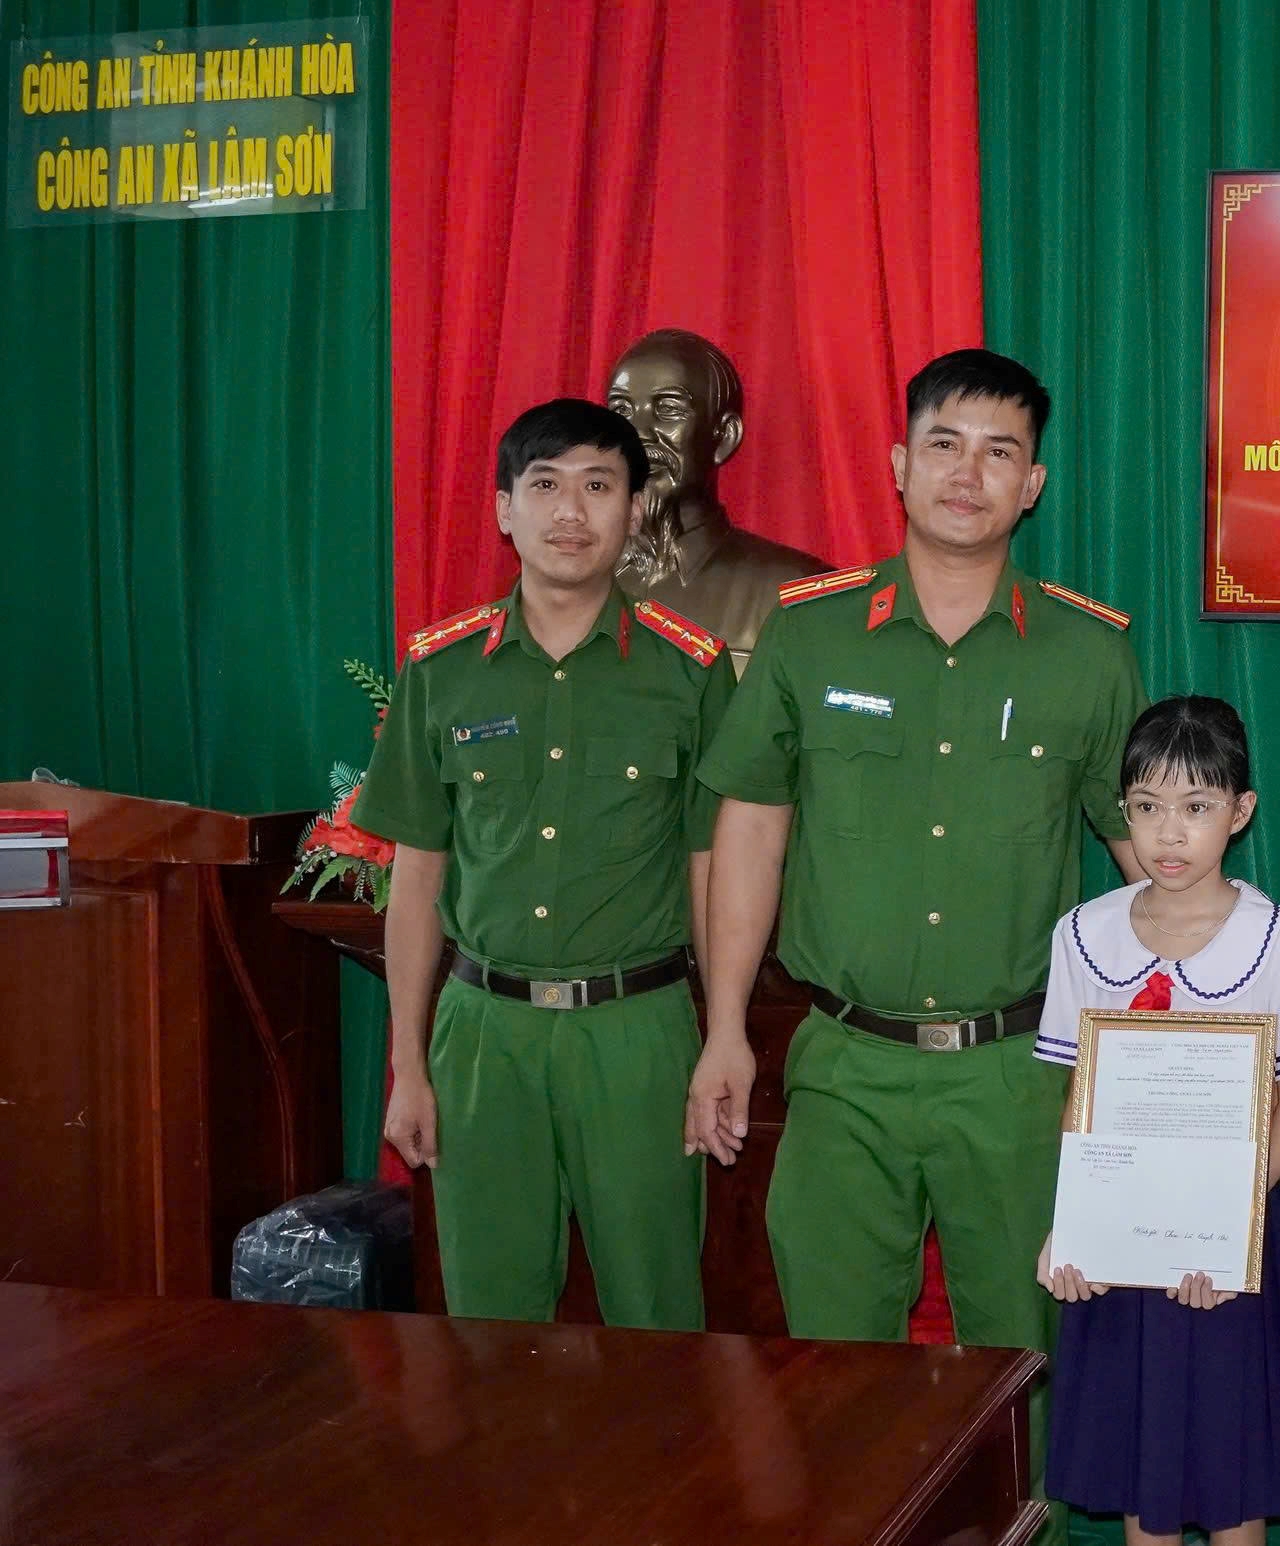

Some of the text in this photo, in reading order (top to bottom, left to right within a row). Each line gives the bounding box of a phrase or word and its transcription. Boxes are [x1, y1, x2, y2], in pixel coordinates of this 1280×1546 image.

[22, 33, 356, 115] CÔNG AN TỈNH KHÁNH HÒA
[37, 125, 332, 212] CÔNG AN XÃ LÂM SƠN
